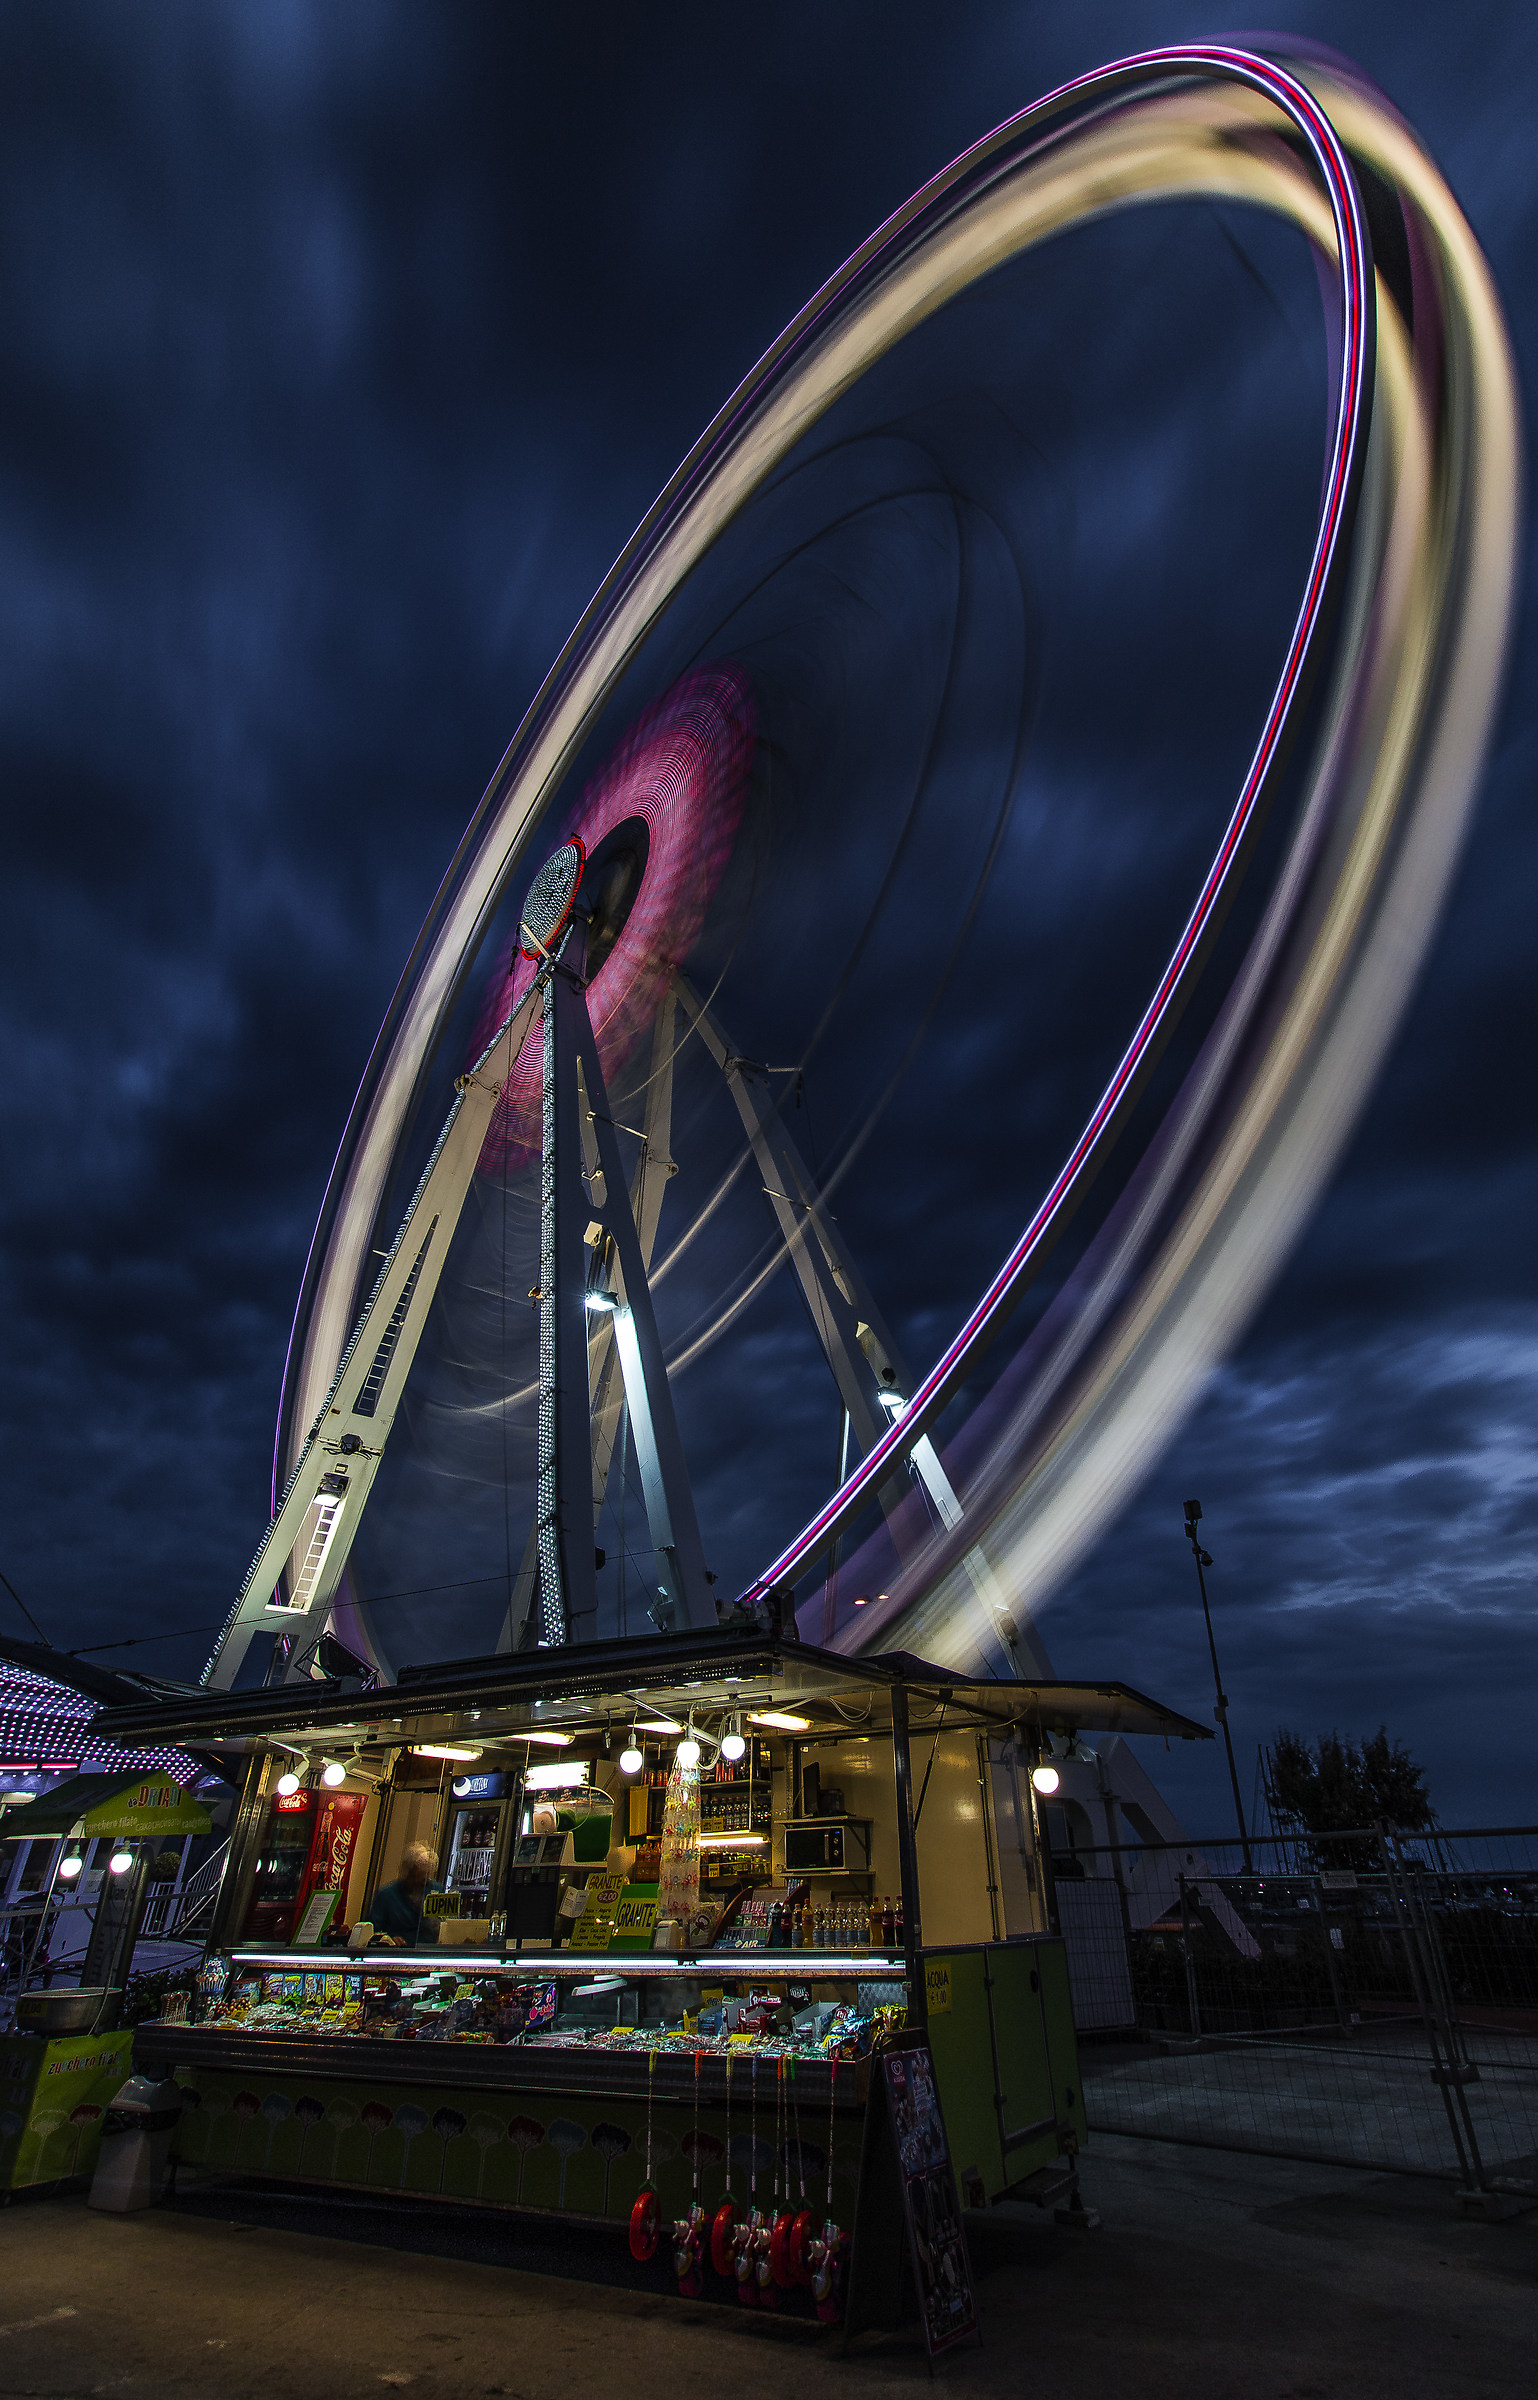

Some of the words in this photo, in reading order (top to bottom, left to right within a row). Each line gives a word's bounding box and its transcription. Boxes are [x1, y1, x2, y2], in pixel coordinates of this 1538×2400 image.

[138, 1785, 182, 1808] DRIADI
[589, 1874, 623, 1890] GRANITE
[426, 1897, 458, 1914] LUPINI
[618, 1903, 656, 1927] GRANITE
[741, 1939, 759, 1949] AIR
[927, 1970, 949, 1988] ACQUA
[48, 2056, 96, 2075] zucchero
[98, 2051, 124, 2066] filato
